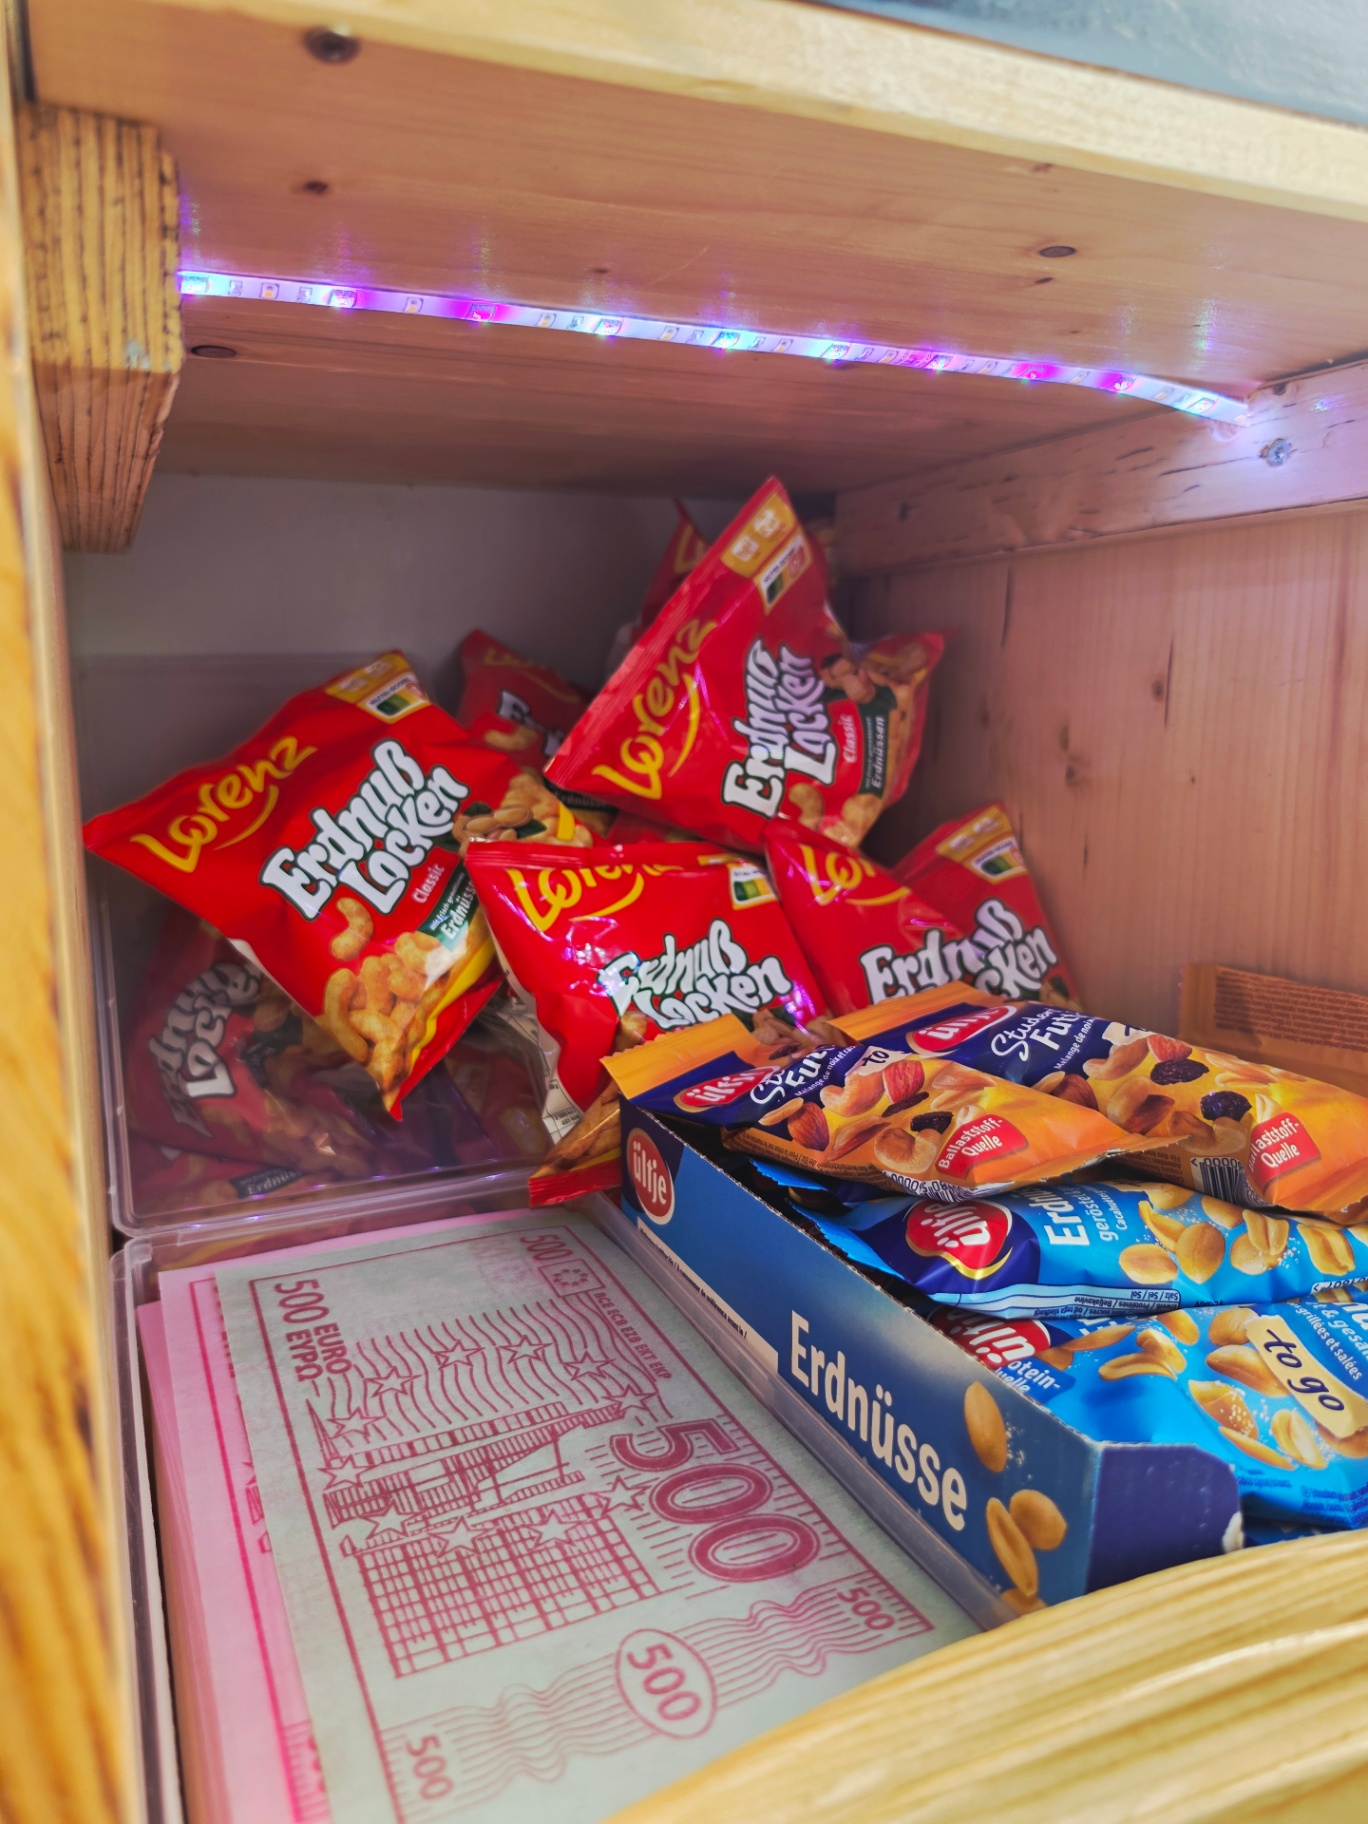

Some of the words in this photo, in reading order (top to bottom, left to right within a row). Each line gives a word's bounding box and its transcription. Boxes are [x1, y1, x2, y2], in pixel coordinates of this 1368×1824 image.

[591, 618, 718, 799] Lorenz
[775, 645, 838, 786] Locken
[838, 713, 858, 764] Classic
[131, 735, 317, 873] Lorenz
[261, 738, 427, 921] Erdnuß
[338, 764, 470, 915] Locken
[412, 863, 446, 904] Classic
[440, 881, 476, 940] Erdnüss
[974, 926, 1057, 999] cken
[862, 1050, 889, 1067] to
[632, 1140, 667, 1204] ültje
[938, 1117, 1003, 1168] Ballaststoff-
[961, 1134, 1003, 1157] Quelle
[1261, 1142, 1300, 1168] Quelle
[519, 1234, 574, 1262] 500
[273, 1279, 330, 1324] 500
[313, 1322, 353, 1375] EURO
[1131, 1290, 1141, 1299] Sol
[1148, 1290, 1158, 1299] Sel
[1164, 1291, 1178, 1300] Salz
[593, 1291, 615, 1310] BCE
[607, 1308, 628, 1326] ECB
[620, 1325, 642, 1344] EZB
[634, 1343, 658, 1362] EKT
[648, 1360, 673, 1380] EKP
[1294, 1305, 1330, 1340] grillées
[1326, 1337, 1342, 1351] et
[1335, 1348, 1363, 1381] salées
[1007, 1360, 1061, 1389] otein-
[1263, 1329, 1302, 1369] to
[1287, 1376, 1345, 1411] go
[791, 1310, 968, 1532] Erdnüsse
[610, 1419, 820, 1583] 500
[837, 1587, 896, 1631] 500
[627, 1642, 703, 1721] 500
[405, 1733, 455, 1801] 500
